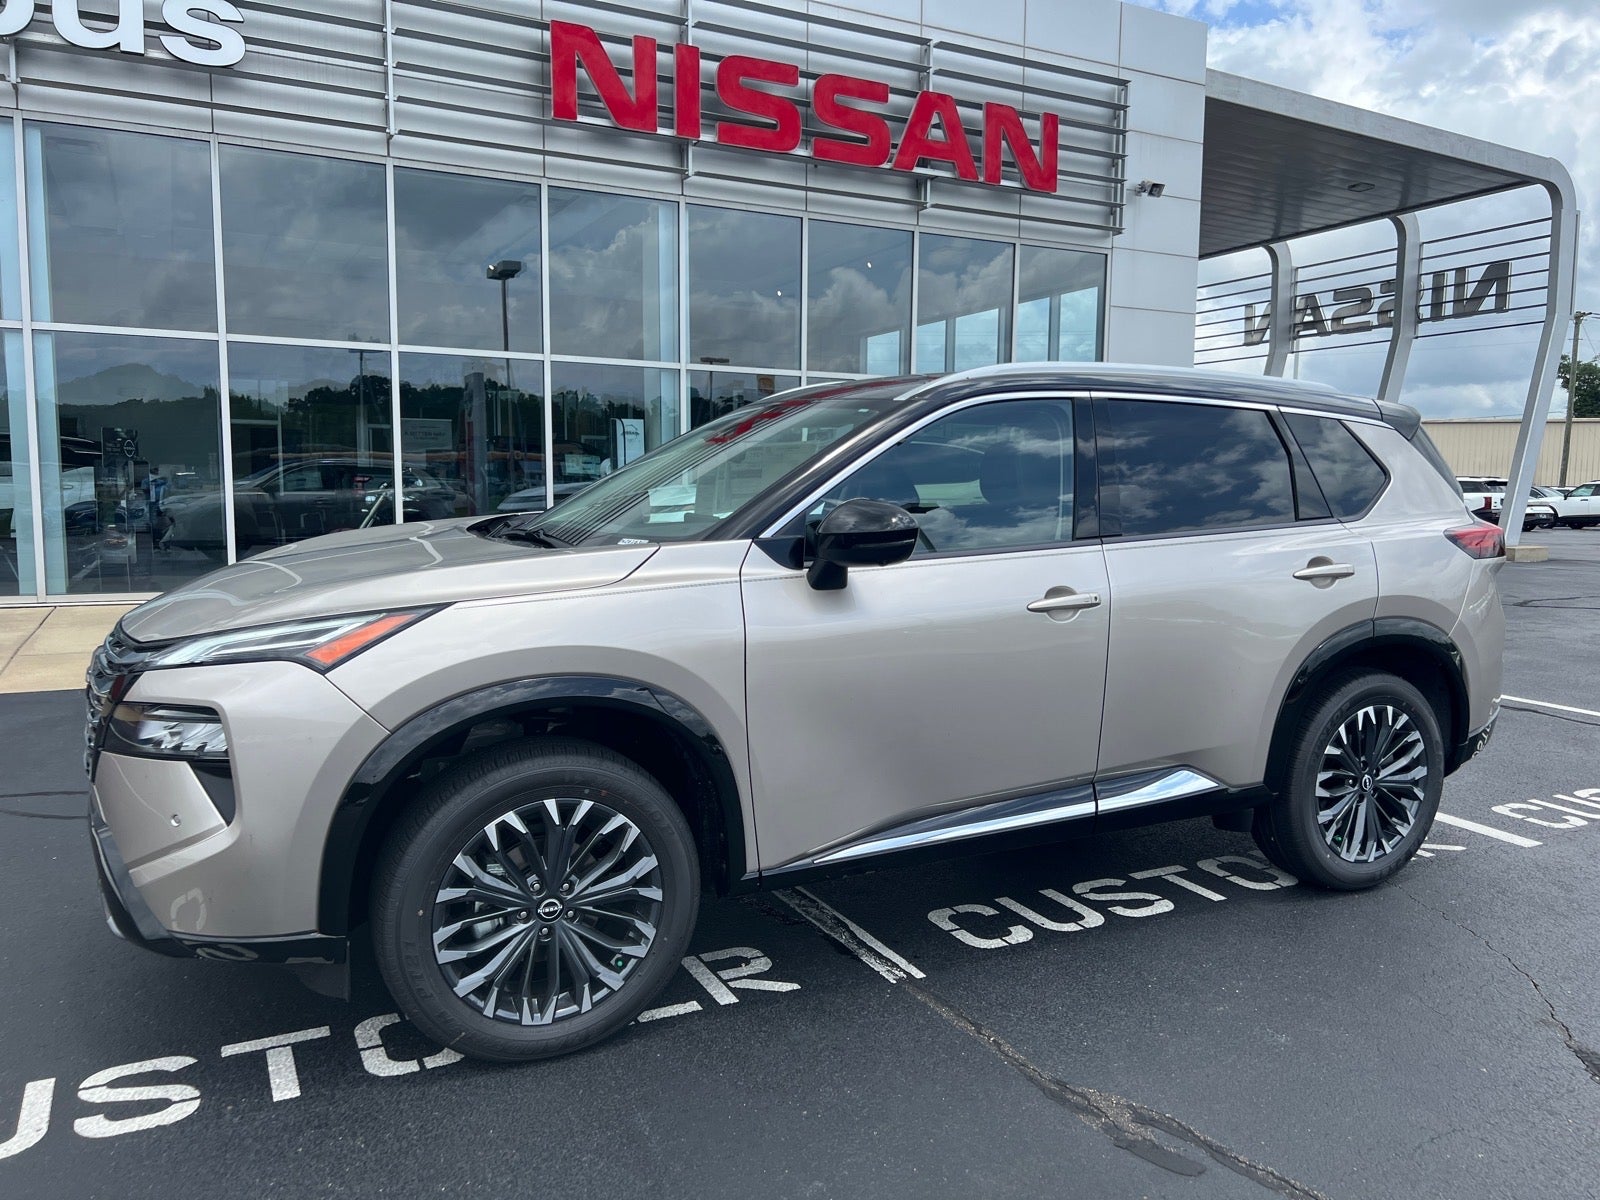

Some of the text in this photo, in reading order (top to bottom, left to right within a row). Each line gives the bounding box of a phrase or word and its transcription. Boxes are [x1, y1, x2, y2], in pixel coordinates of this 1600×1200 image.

[0, 0, 246, 67] us
[550, 20, 1058, 193] NISSAN
[1491, 788, 1600, 829] CU
[538, 904, 563, 914] NISSAN
[927, 840, 1467, 949] CUSTO
